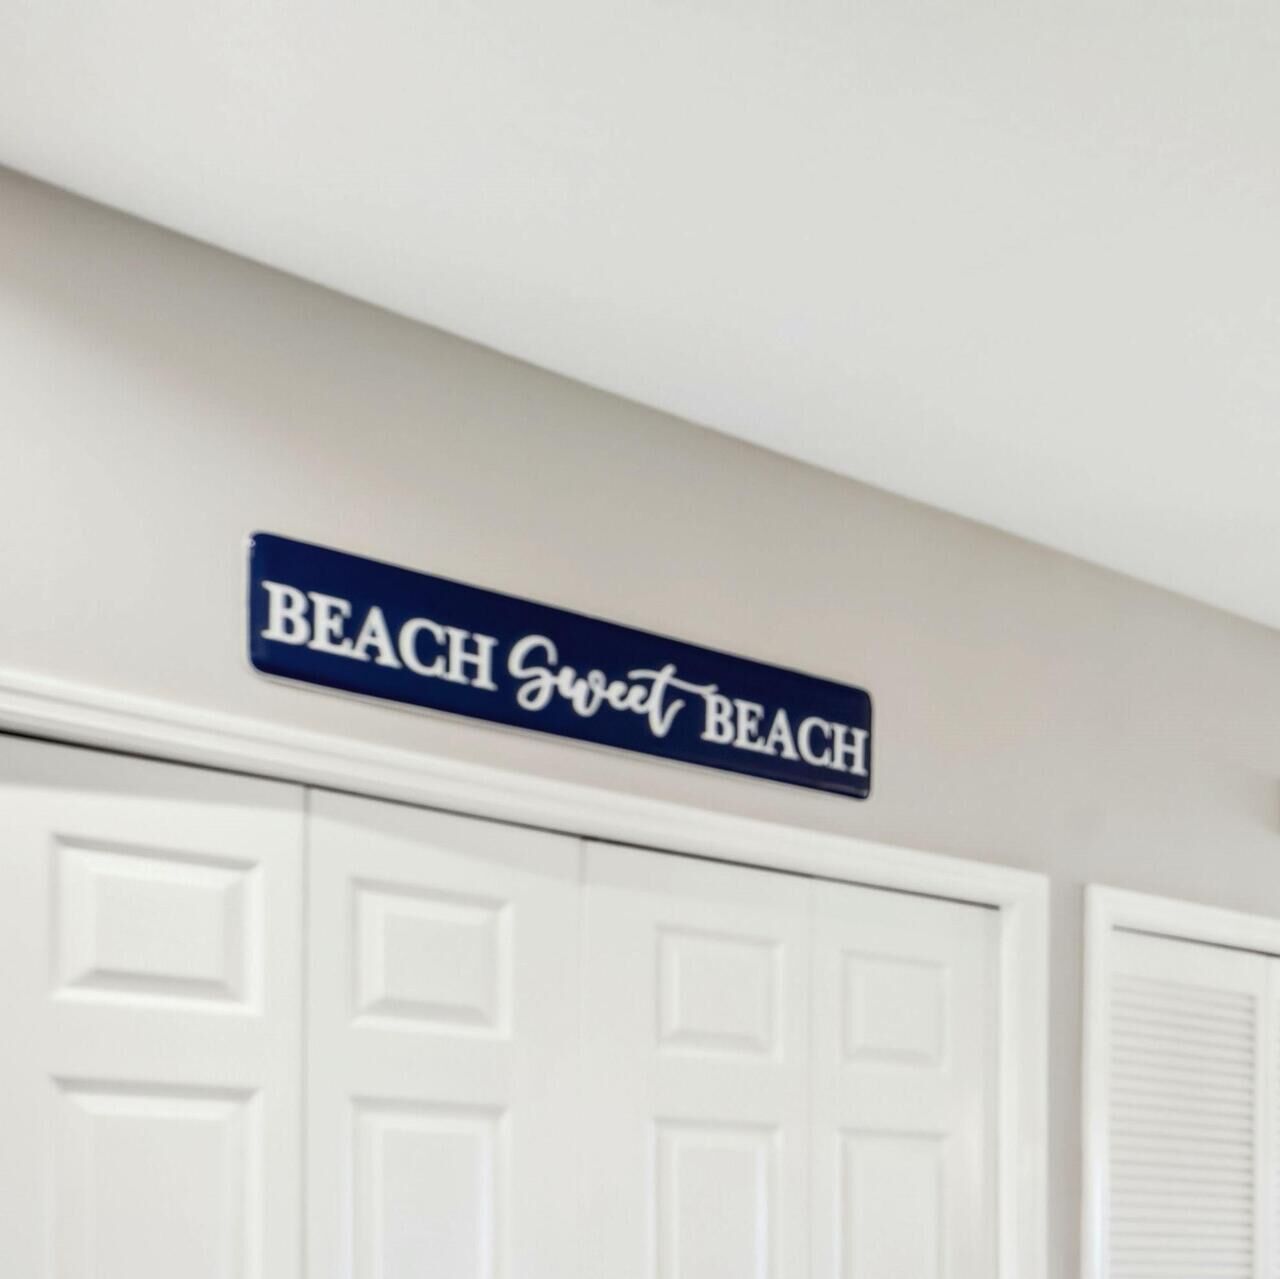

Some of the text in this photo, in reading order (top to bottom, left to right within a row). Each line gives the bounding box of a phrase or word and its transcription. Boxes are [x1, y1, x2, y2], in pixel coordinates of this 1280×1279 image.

[261, 580, 870, 777] BEACH Sweet BEACH
